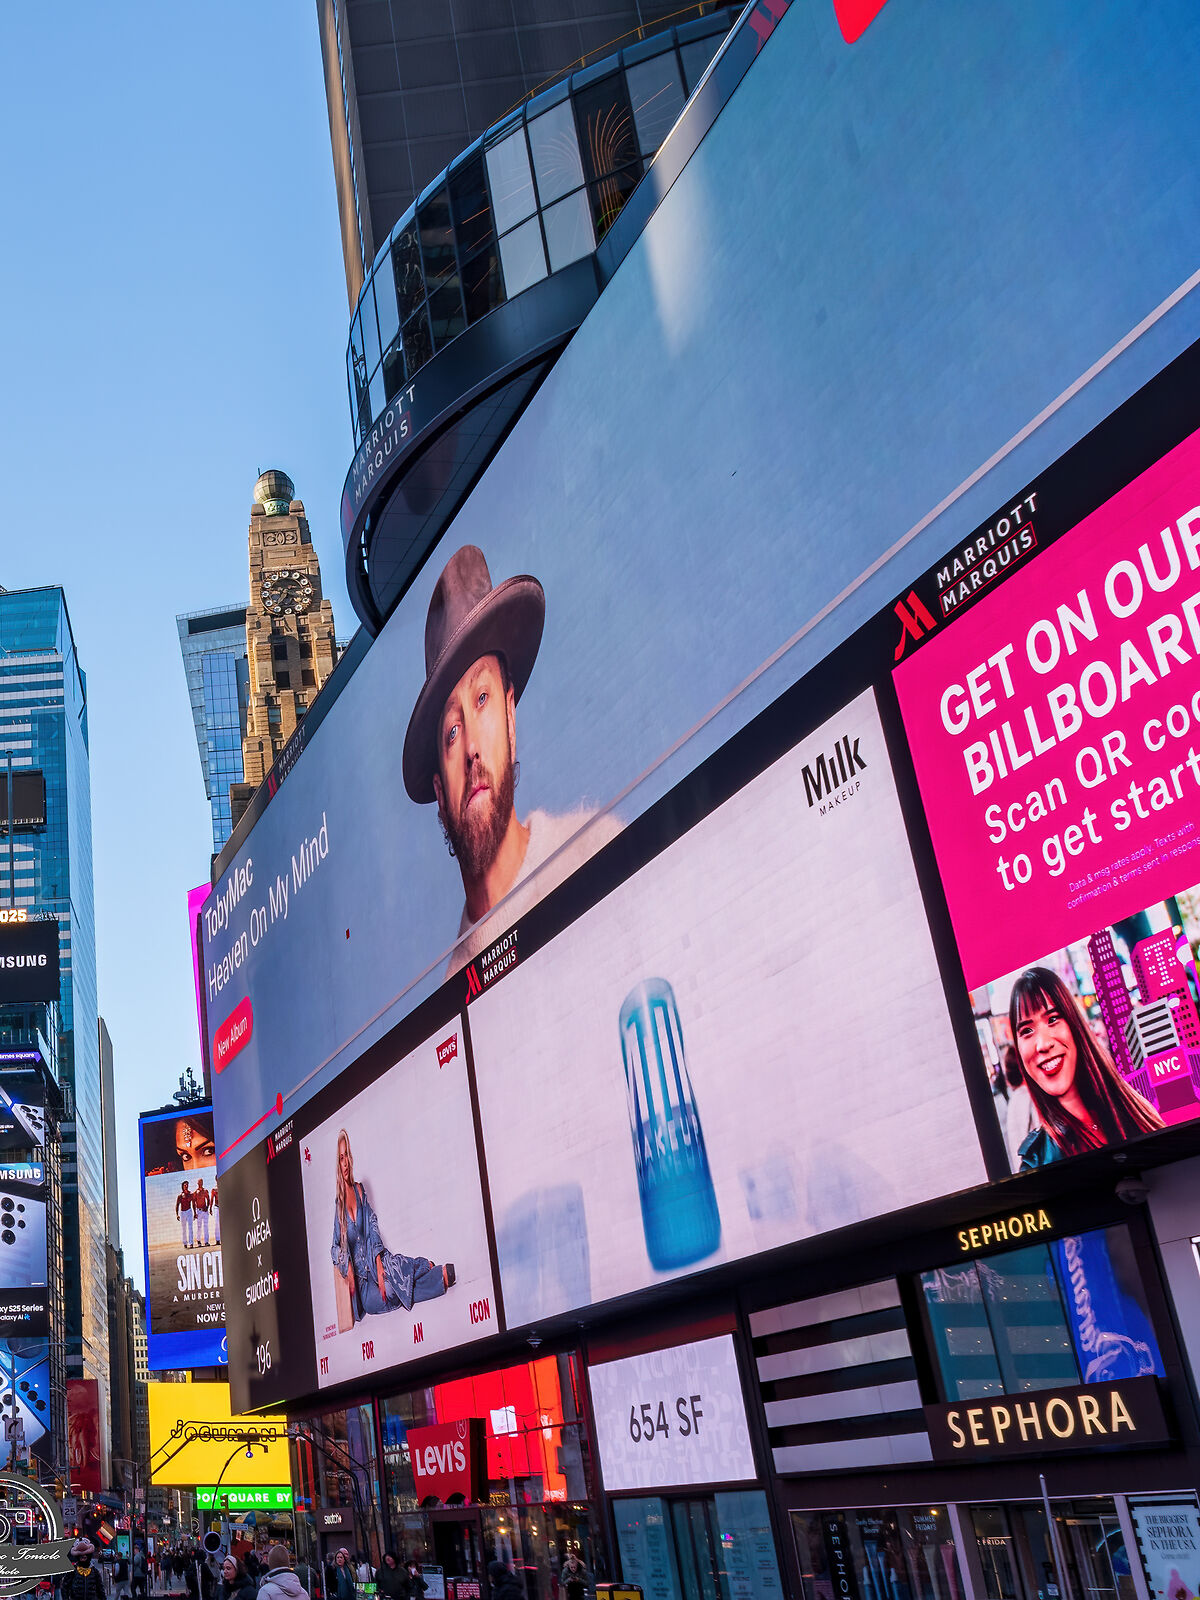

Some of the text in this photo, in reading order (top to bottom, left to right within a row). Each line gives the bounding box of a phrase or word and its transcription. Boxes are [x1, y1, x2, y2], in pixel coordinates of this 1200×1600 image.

[352, 384, 416, 483] MARRIOTT
[355, 419, 408, 504] MARQUIS
[936, 492, 1037, 588] MARRIOTT
[942, 529, 1033, 612] MARQUIS
[940, 643, 1015, 735] GET
[1026, 589, 1099, 675] ON
[800, 734, 867, 807] Milk
[985, 777, 1068, 844] Scan
[1075, 730, 1132, 789] QR
[819, 781, 862, 816] MAKEUP
[996, 747, 1200, 891] to get start
[1069, 878, 1086, 892] Data
[1087, 873, 1093, 883] &
[1094, 866, 1110, 880] msg
[1111, 856, 1130, 872] rates
[1154, 832, 1176, 847] Texts
[1177, 822, 1195, 837] with
[205, 857, 254, 943] TobyMac
[1067, 883, 1112, 909] confirmation
[1113, 876, 1119, 887] &
[1120, 866, 1142, 882] terms
[1143, 857, 1160, 872] sent
[208, 811, 329, 1002] Heaven On My Mind
[482, 929, 518, 969] MARRIOTT
[484, 949, 516, 984] MARQUIS
[218, 1015, 248, 1060] New Album
[1153, 1056, 1180, 1077] NYC
[246, 1219, 272, 1251] OMEGA
[957, 1209, 1052, 1251] SEPHORA
[177, 1254, 202, 1292] SIN
[246, 1269, 274, 1305] swatch
[21, 1304, 44, 1312] Series
[183, 1291, 220, 1302] MURDER
[197, 1312, 219, 1323] NOW
[320, 1298, 491, 1375] FIT FOR AN ICON
[629, 1394, 704, 1443] 654 SF
[947, 1391, 1137, 1448] SEPHORA
[64, 1508, 75, 1516] 25
[276, 1492, 291, 1503] BY
[1145, 1514, 1189, 1525] THE BIGGEST
[1147, 1526, 1194, 1538] SEPHORA
[1151, 1540, 1197, 1551] IN THE USA
